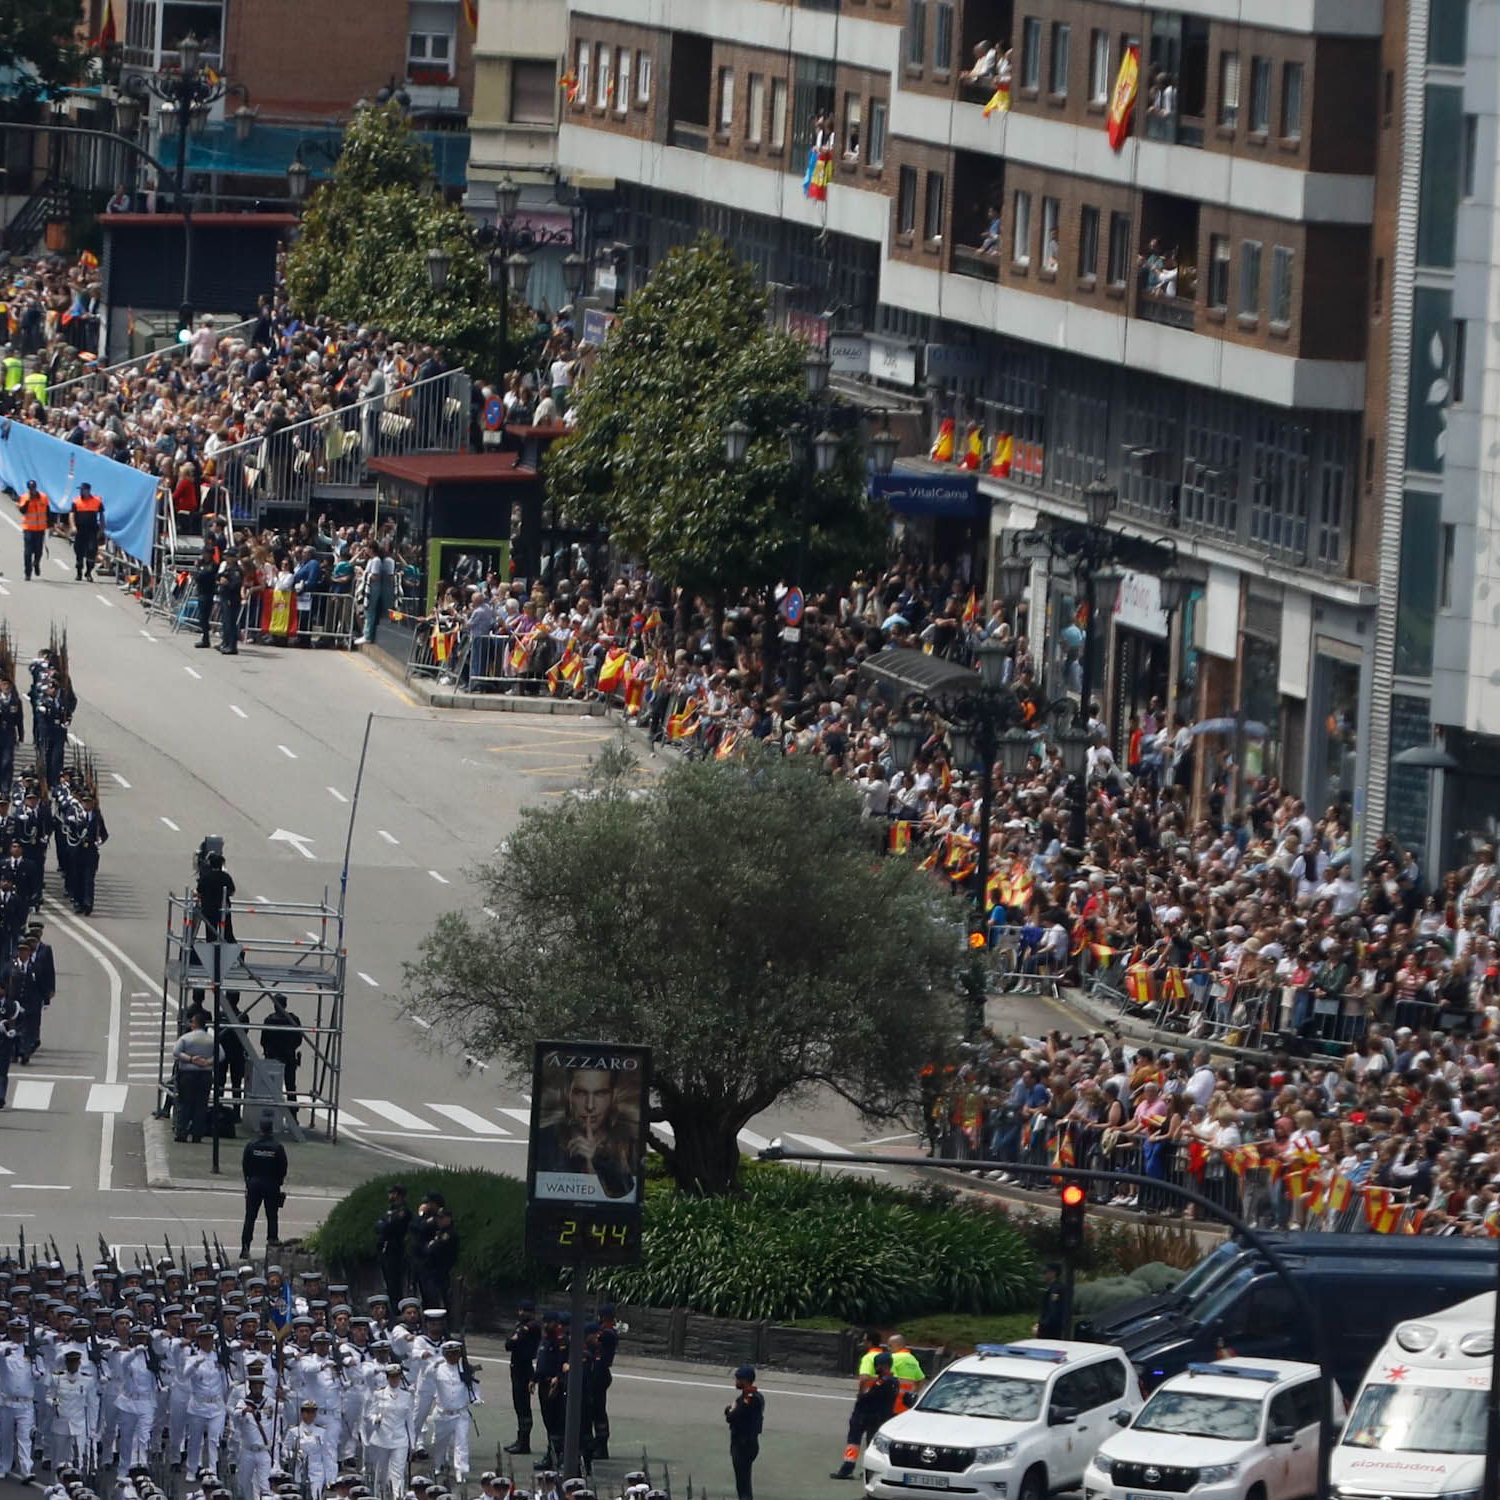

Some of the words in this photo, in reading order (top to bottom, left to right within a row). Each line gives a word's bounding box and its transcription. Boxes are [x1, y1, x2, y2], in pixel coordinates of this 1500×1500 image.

[909, 487, 969, 500] VitalCama
[548, 1055, 639, 1072] AZZARO
[546, 1183, 596, 1196] WANTED
